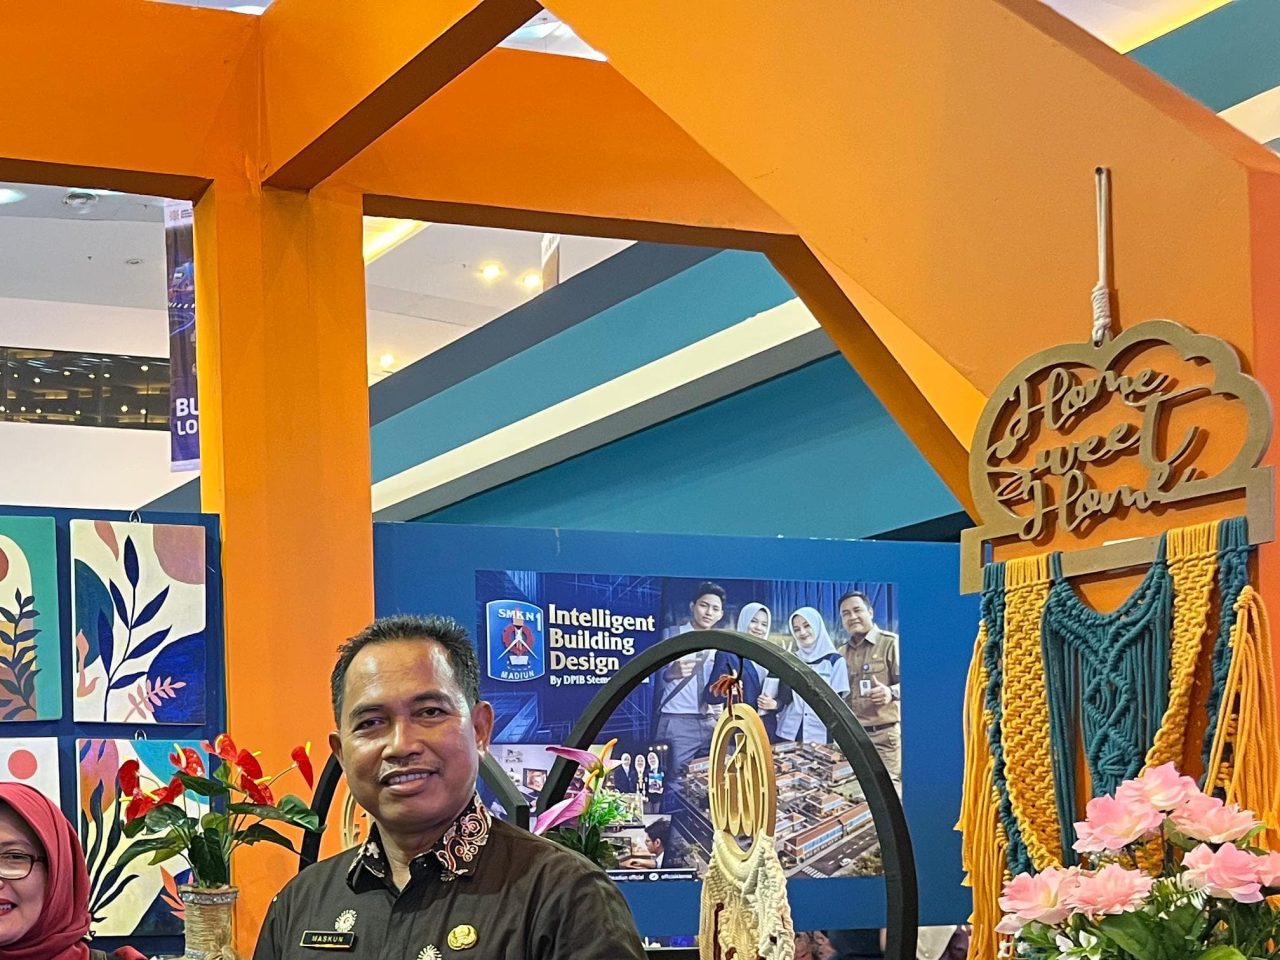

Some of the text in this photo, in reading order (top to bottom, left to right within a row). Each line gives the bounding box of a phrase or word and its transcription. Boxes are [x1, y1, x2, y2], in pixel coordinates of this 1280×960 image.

[987, 367, 1168, 458] Home
[1018, 466, 1198, 540] Home
[548, 604, 656, 634] Intelligent
[549, 628, 635, 656] Building
[500, 670, 535, 681] MADIUN
[550, 650, 620, 675] Design
[549, 675, 562, 688] By
[563, 675, 586, 685] DPIB
[311, 935, 344, 943] MASKUN
